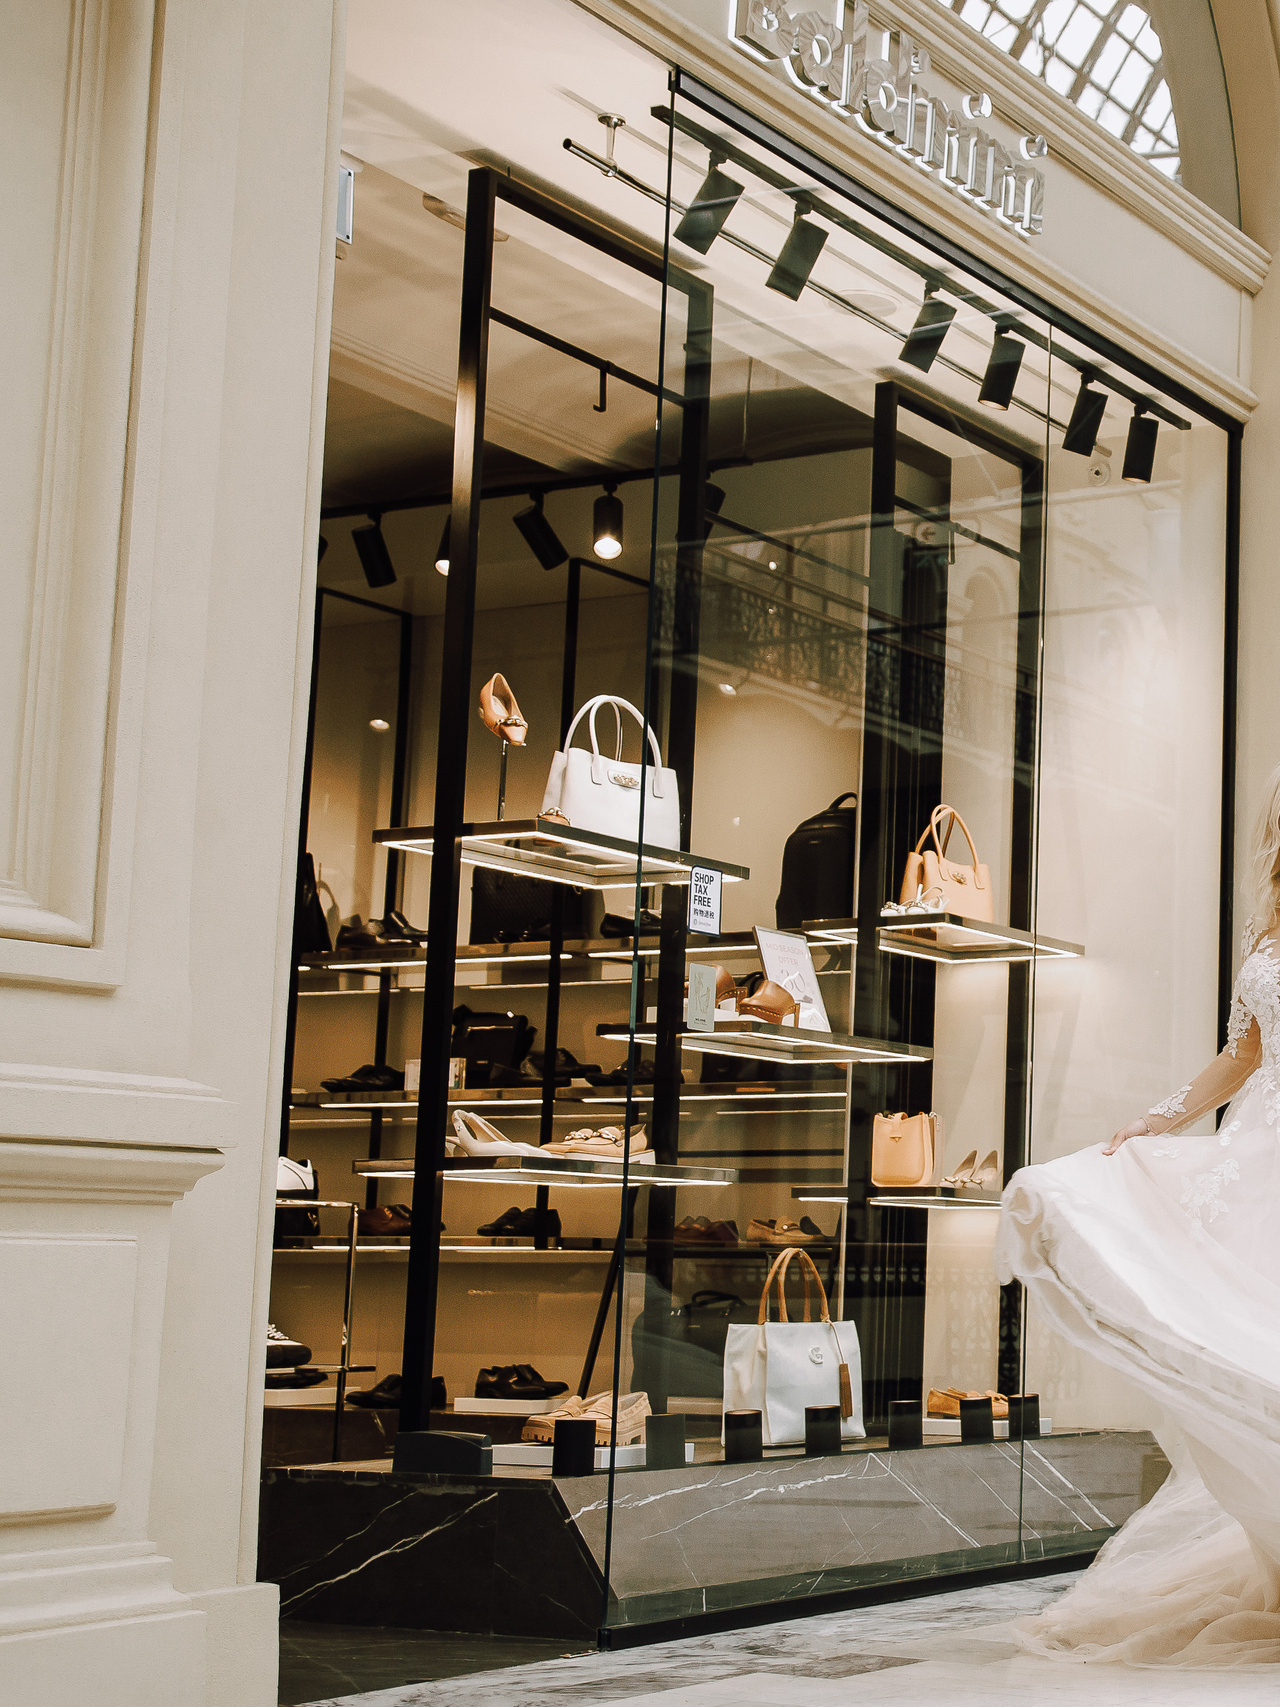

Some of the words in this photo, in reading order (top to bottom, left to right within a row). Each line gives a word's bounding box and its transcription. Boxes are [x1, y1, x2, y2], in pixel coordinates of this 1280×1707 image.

[694, 872, 714, 885] SHOP
[694, 883, 708, 896] TAX
[693, 895, 711, 907] FREE
[779, 944, 805, 955] SEASON
[778, 956, 799, 966] OFFER
